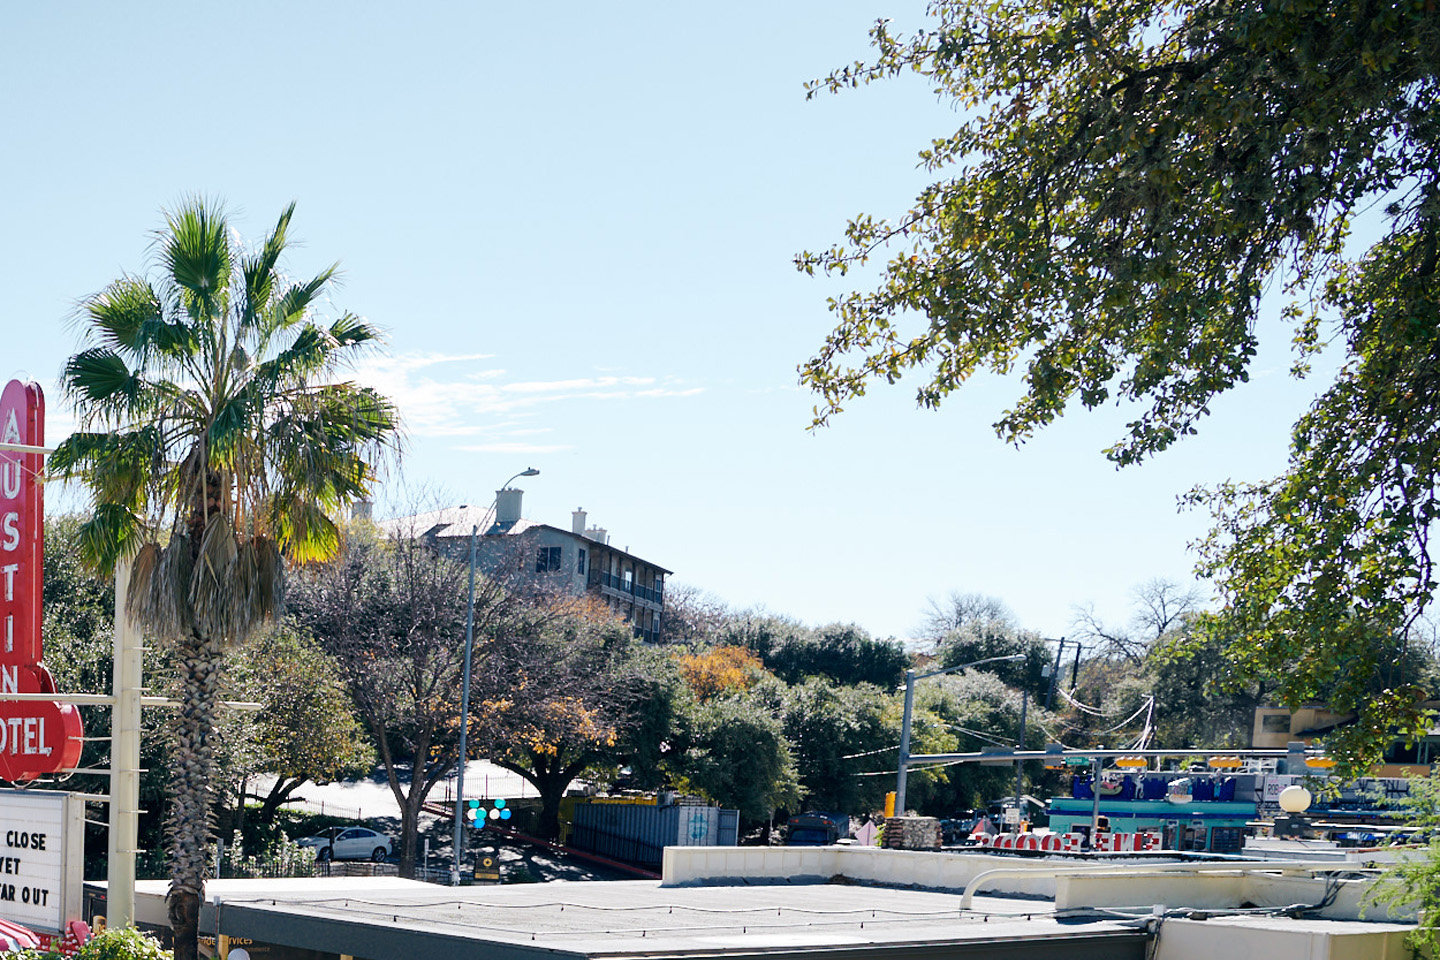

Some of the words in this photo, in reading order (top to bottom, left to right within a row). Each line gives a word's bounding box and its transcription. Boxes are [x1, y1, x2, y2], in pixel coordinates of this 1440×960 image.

[0, 407, 22, 703] AUSTIN
[6, 830, 46, 851] CLOSE
[22, 886, 49, 906] OUT
[222, 937, 253, 945] rvices
